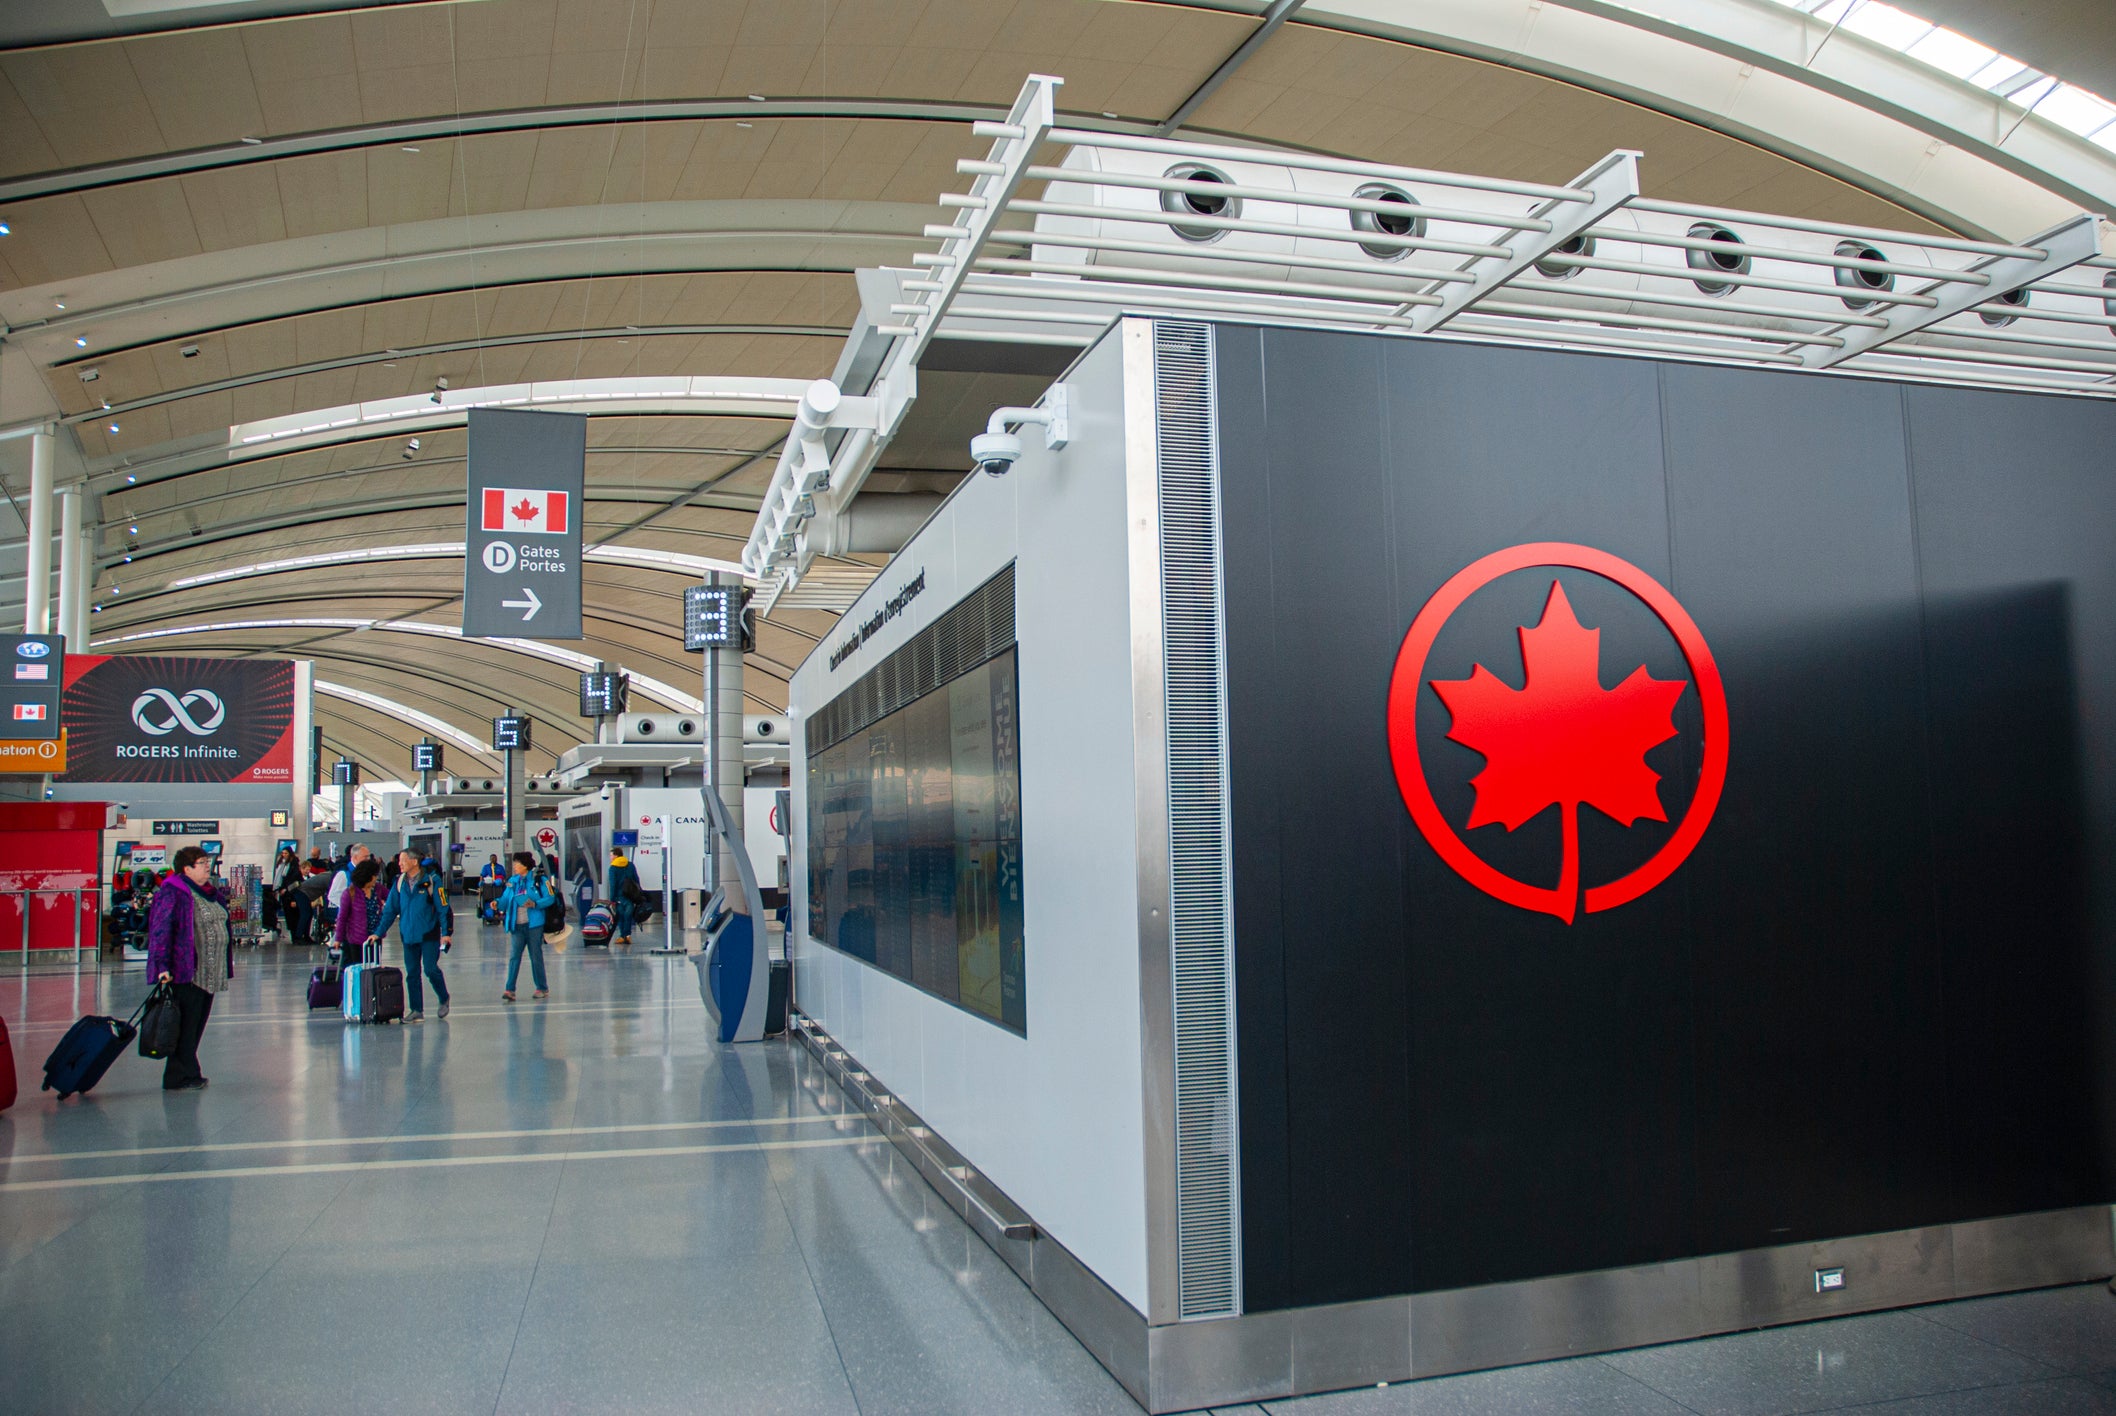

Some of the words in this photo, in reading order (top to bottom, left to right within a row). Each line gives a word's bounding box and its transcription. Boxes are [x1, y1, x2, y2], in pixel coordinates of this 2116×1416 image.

[493, 546, 509, 567] D
[520, 545, 560, 558] Gates
[520, 559, 566, 572] Portes
[695, 592, 727, 640] 3
[587, 676, 610, 710] 4
[500, 720, 517, 746] 5
[0, 744, 35, 756] ation
[116, 745, 180, 758] ROGERS
[417, 746, 432, 768] 6
[994, 688, 1009, 887] WELCOME
[1002, 673, 1018, 901] BIENVENUE
